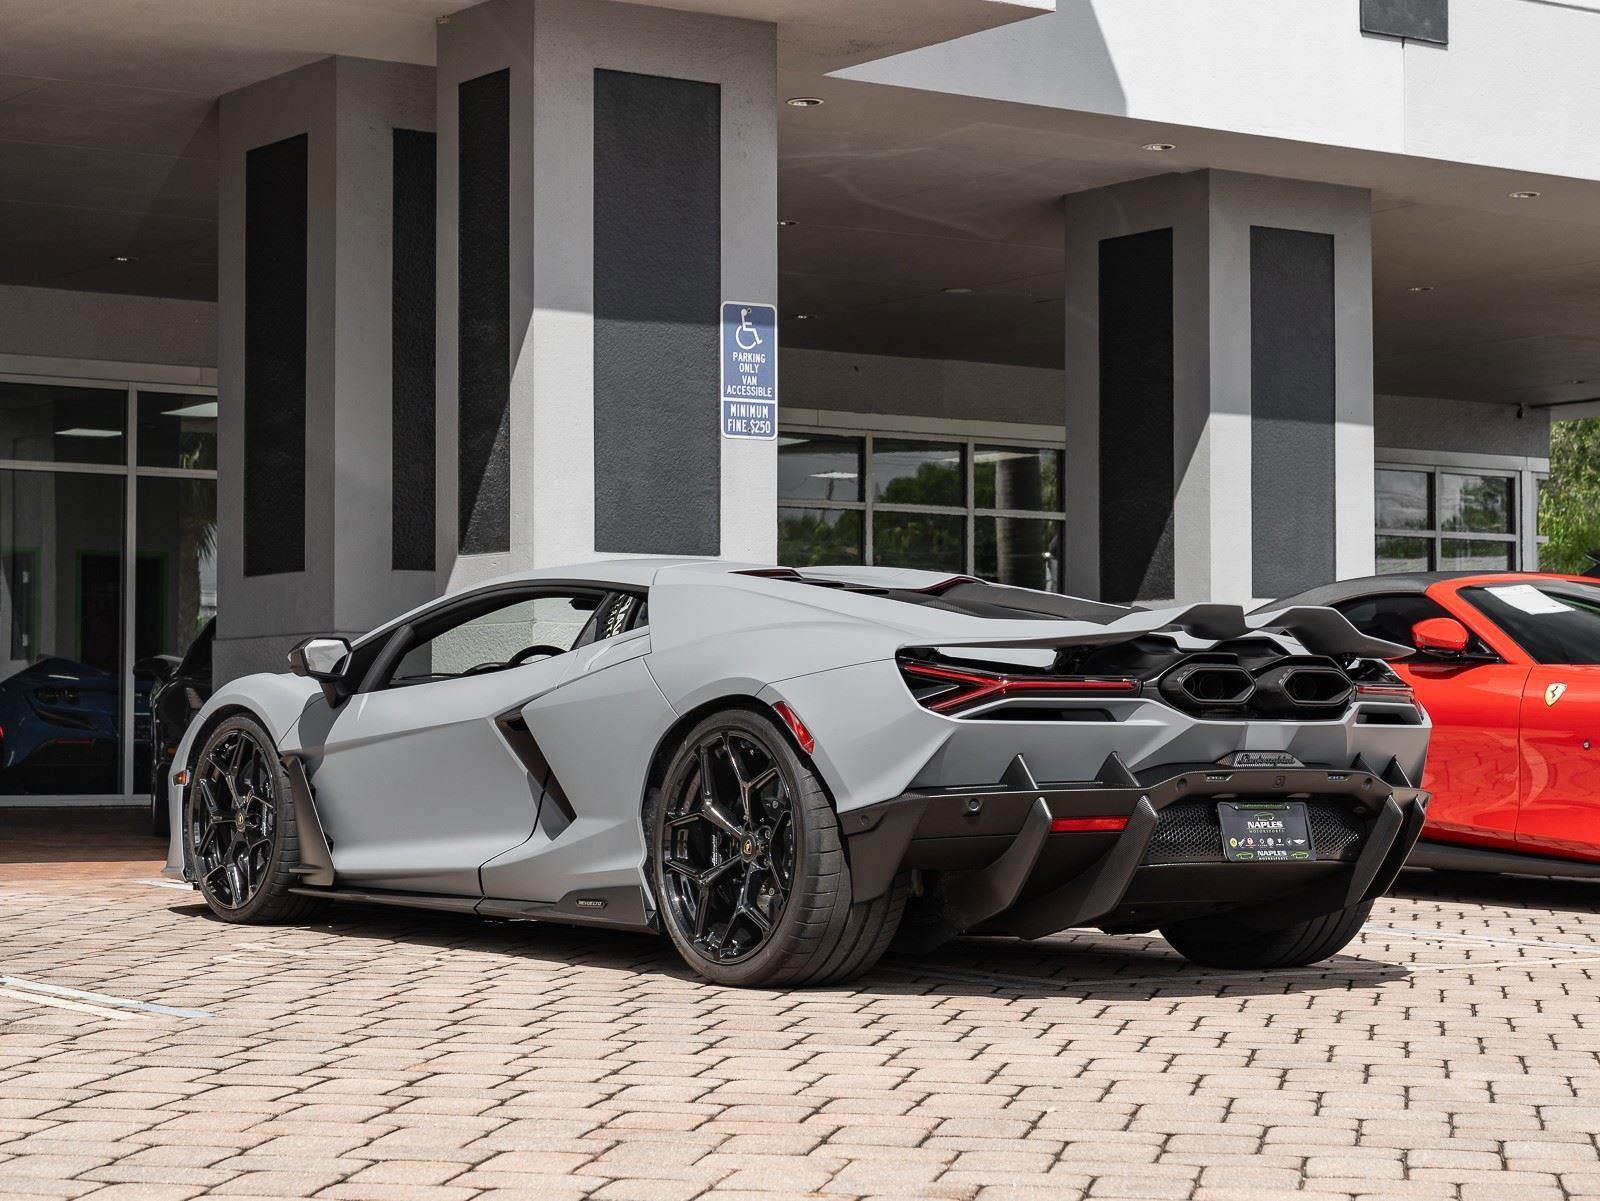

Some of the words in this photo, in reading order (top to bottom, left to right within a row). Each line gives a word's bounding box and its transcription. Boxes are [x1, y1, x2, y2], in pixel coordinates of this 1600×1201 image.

[732, 352, 766, 363] PARKING
[739, 363, 759, 373] ONLY
[742, 375, 757, 385] VAN
[726, 385, 773, 397] ACCESSIBLE
[730, 403, 769, 418] MINIMUM
[727, 419, 748, 433] FINE
[750, 419, 771, 434] $250
